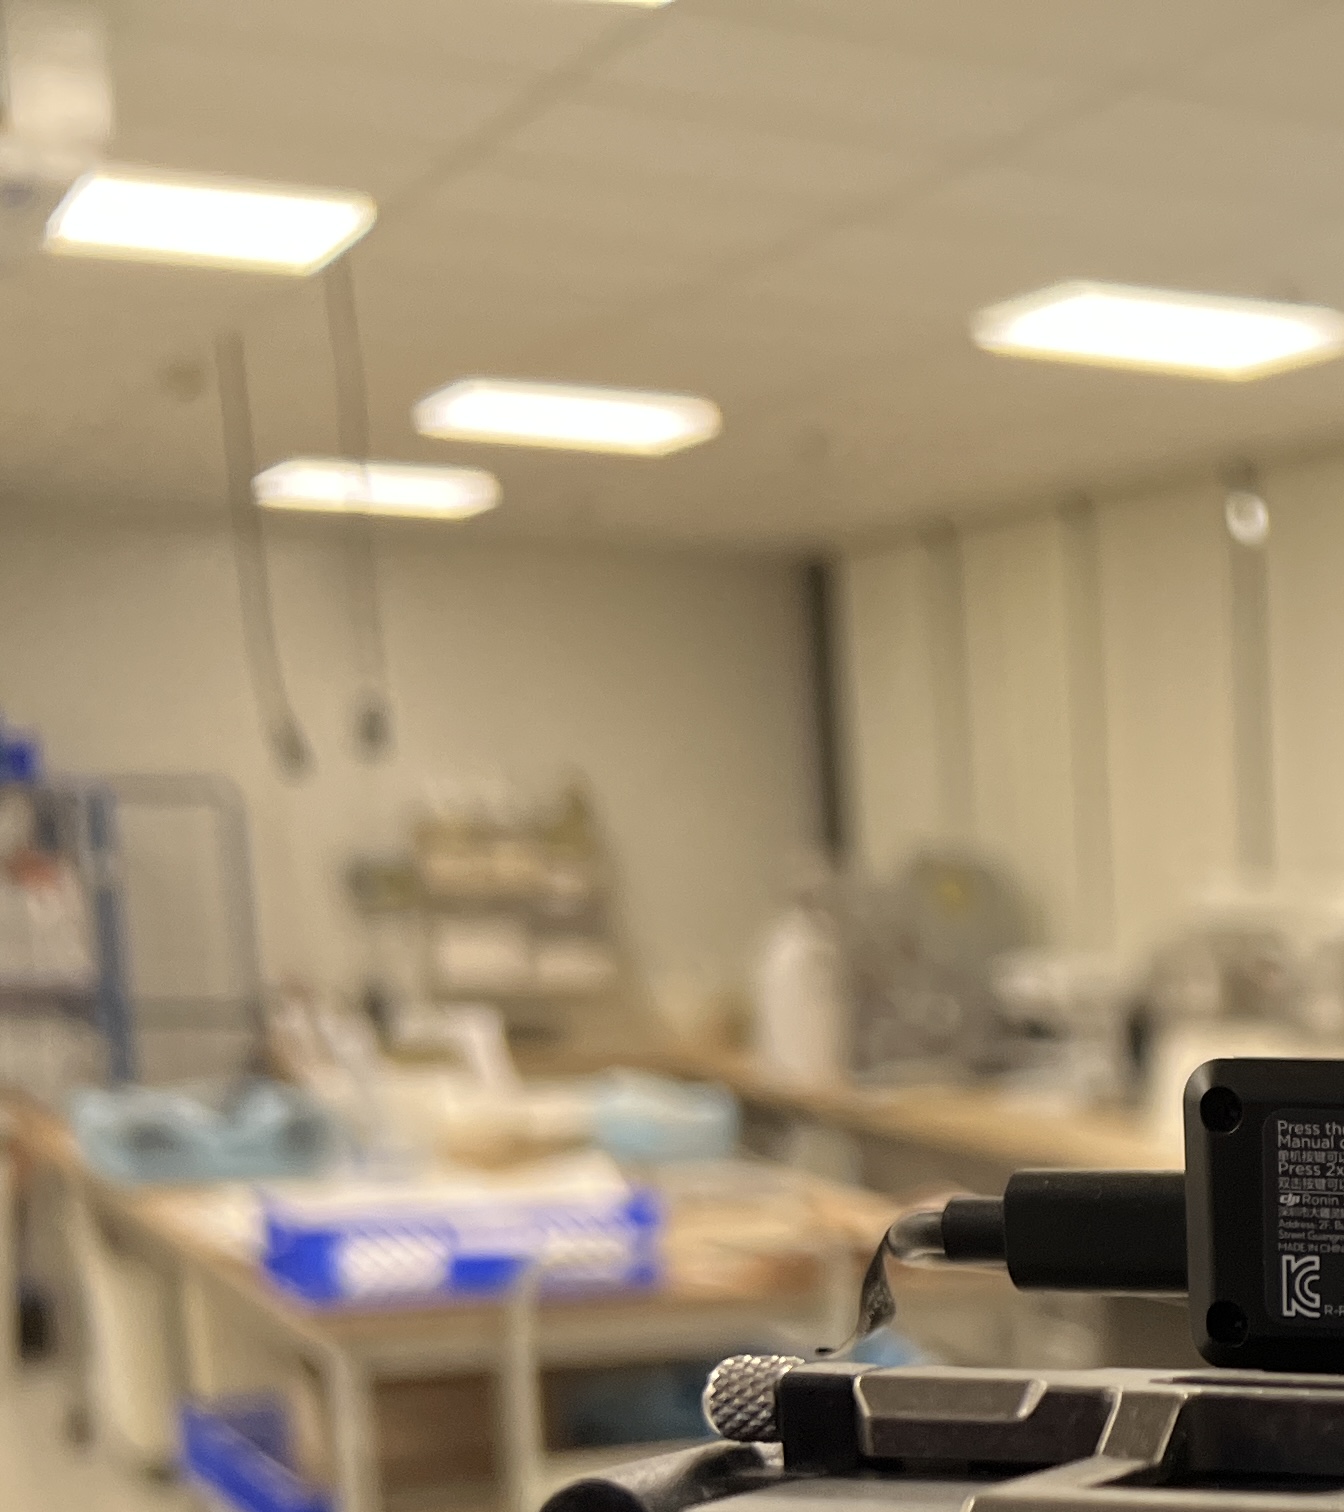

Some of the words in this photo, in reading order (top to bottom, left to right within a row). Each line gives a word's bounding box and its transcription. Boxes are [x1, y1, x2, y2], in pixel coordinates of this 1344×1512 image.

[1277, 1120, 1321, 1136] Press
[1277, 1134, 1335, 1149] Manual
[1278, 1162, 1321, 1176] Press
[1325, 1162, 1344, 1177] 2x
[1301, 1194, 1340, 1206] Ronin
[1278, 1242, 1307, 1252] MADE
